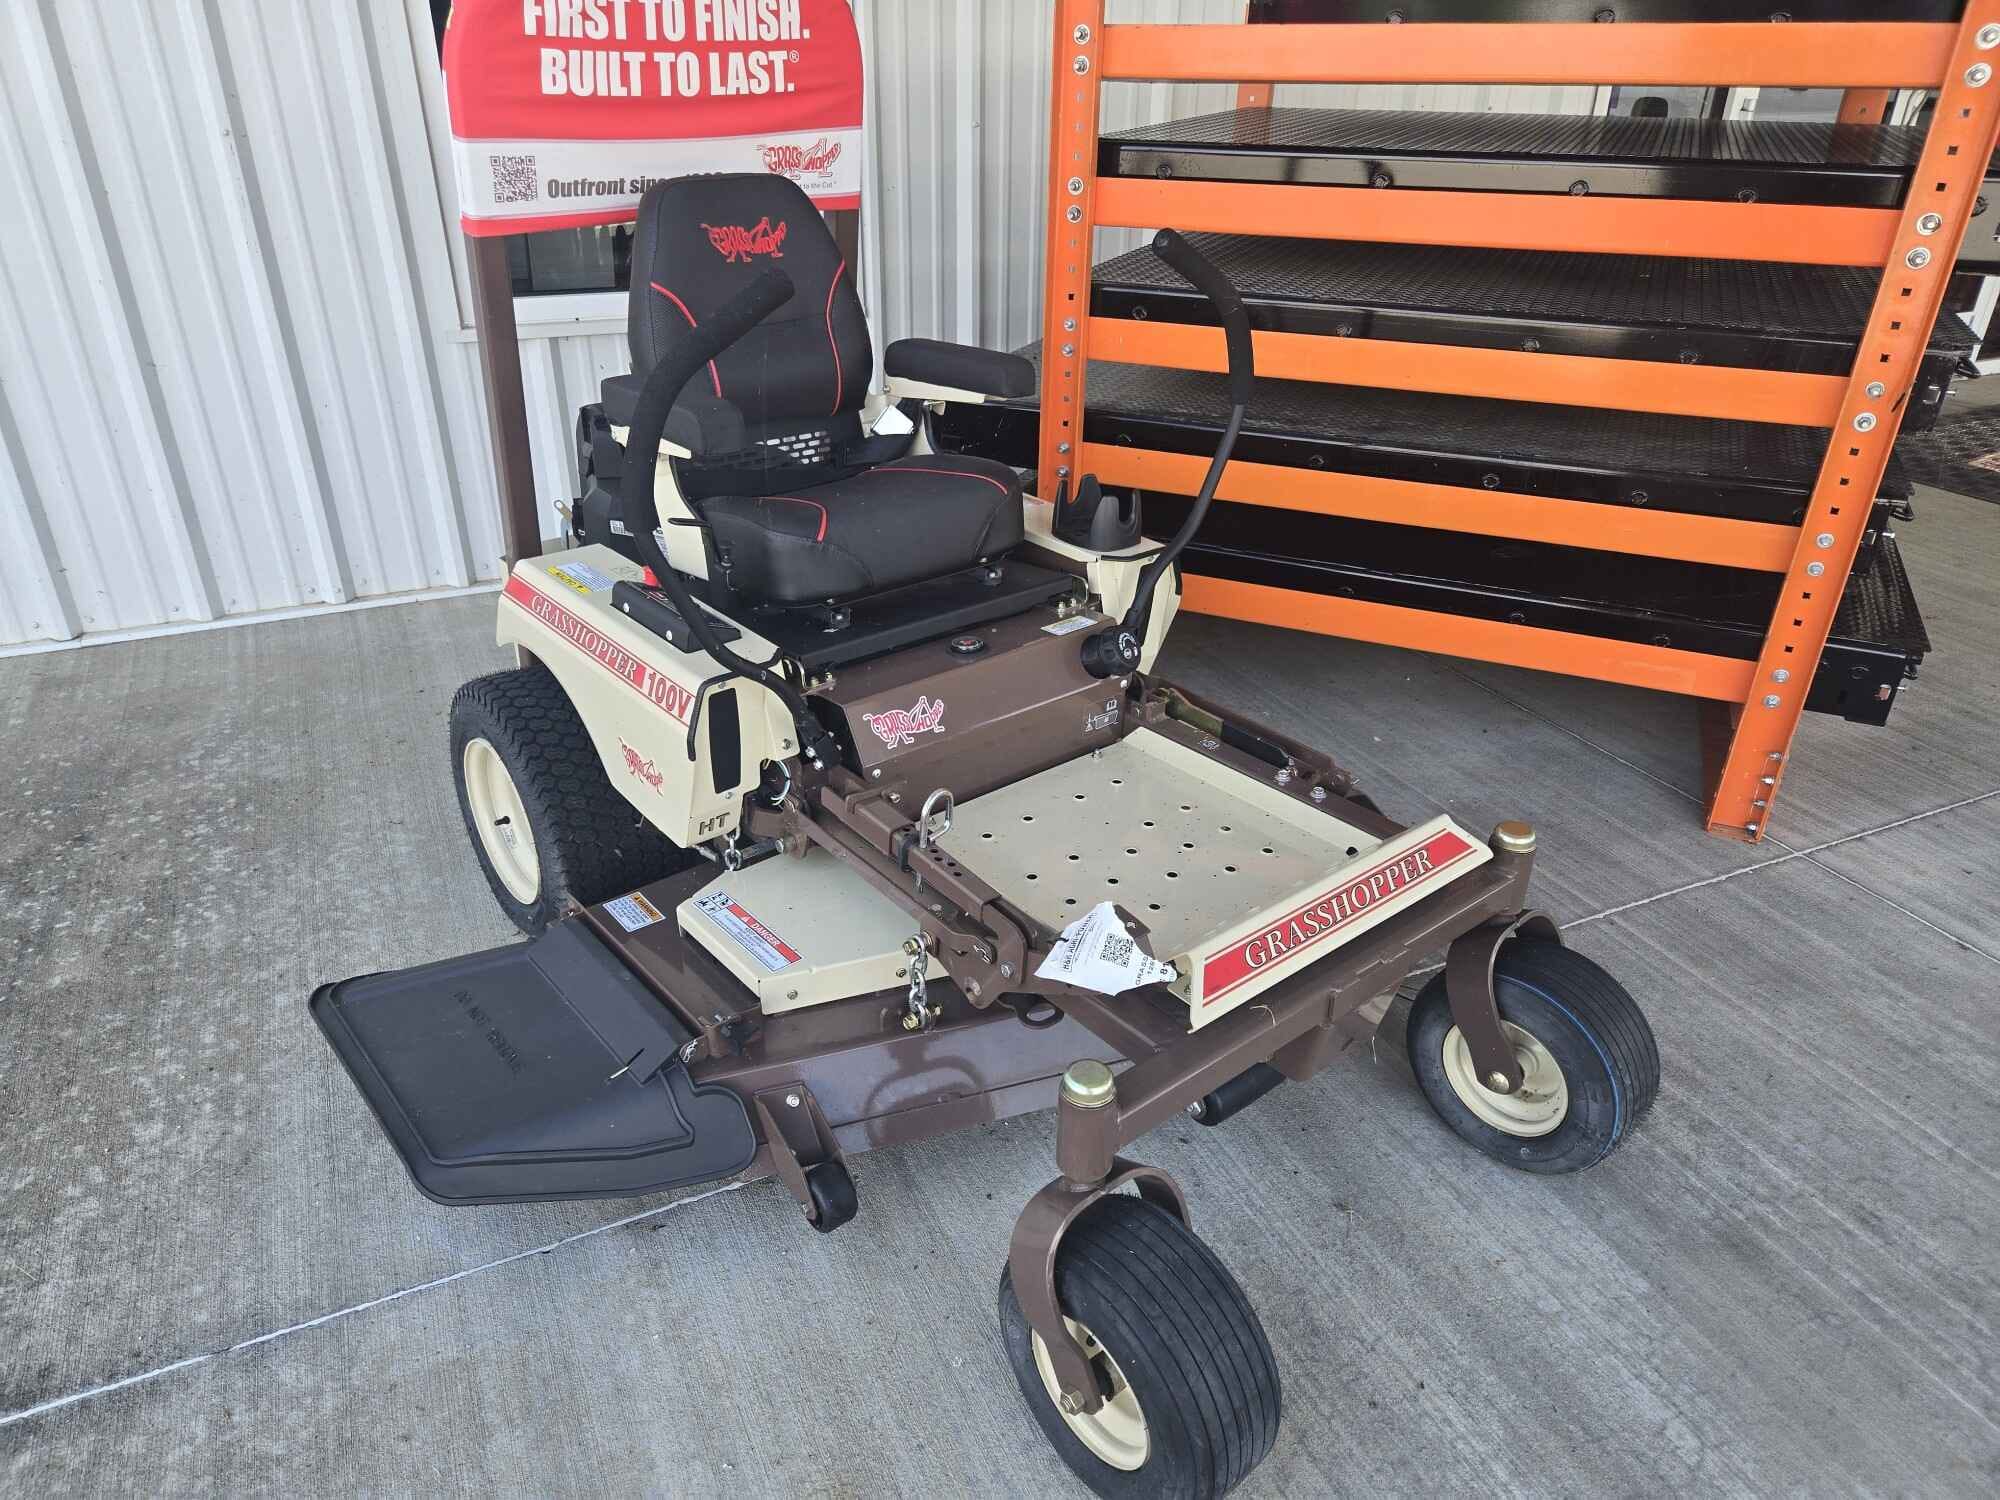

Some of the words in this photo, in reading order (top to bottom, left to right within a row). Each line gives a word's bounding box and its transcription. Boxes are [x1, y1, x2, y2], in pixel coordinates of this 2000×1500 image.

[523, 0, 635, 40] FIRST
[640, 0, 687, 41] TO
[695, 0, 810, 41] FINISH.
[540, 48, 646, 97] BUILT
[653, 51, 700, 97] TO
[547, 178, 627, 198] Outfront
[529, 593, 637, 681] GRASSHOPPER
[647, 670, 692, 719] 100V
[698, 811, 730, 835] HT
[1242, 847, 1437, 971] GRASSHOPPER
[750, 921, 781, 947] DANGER
